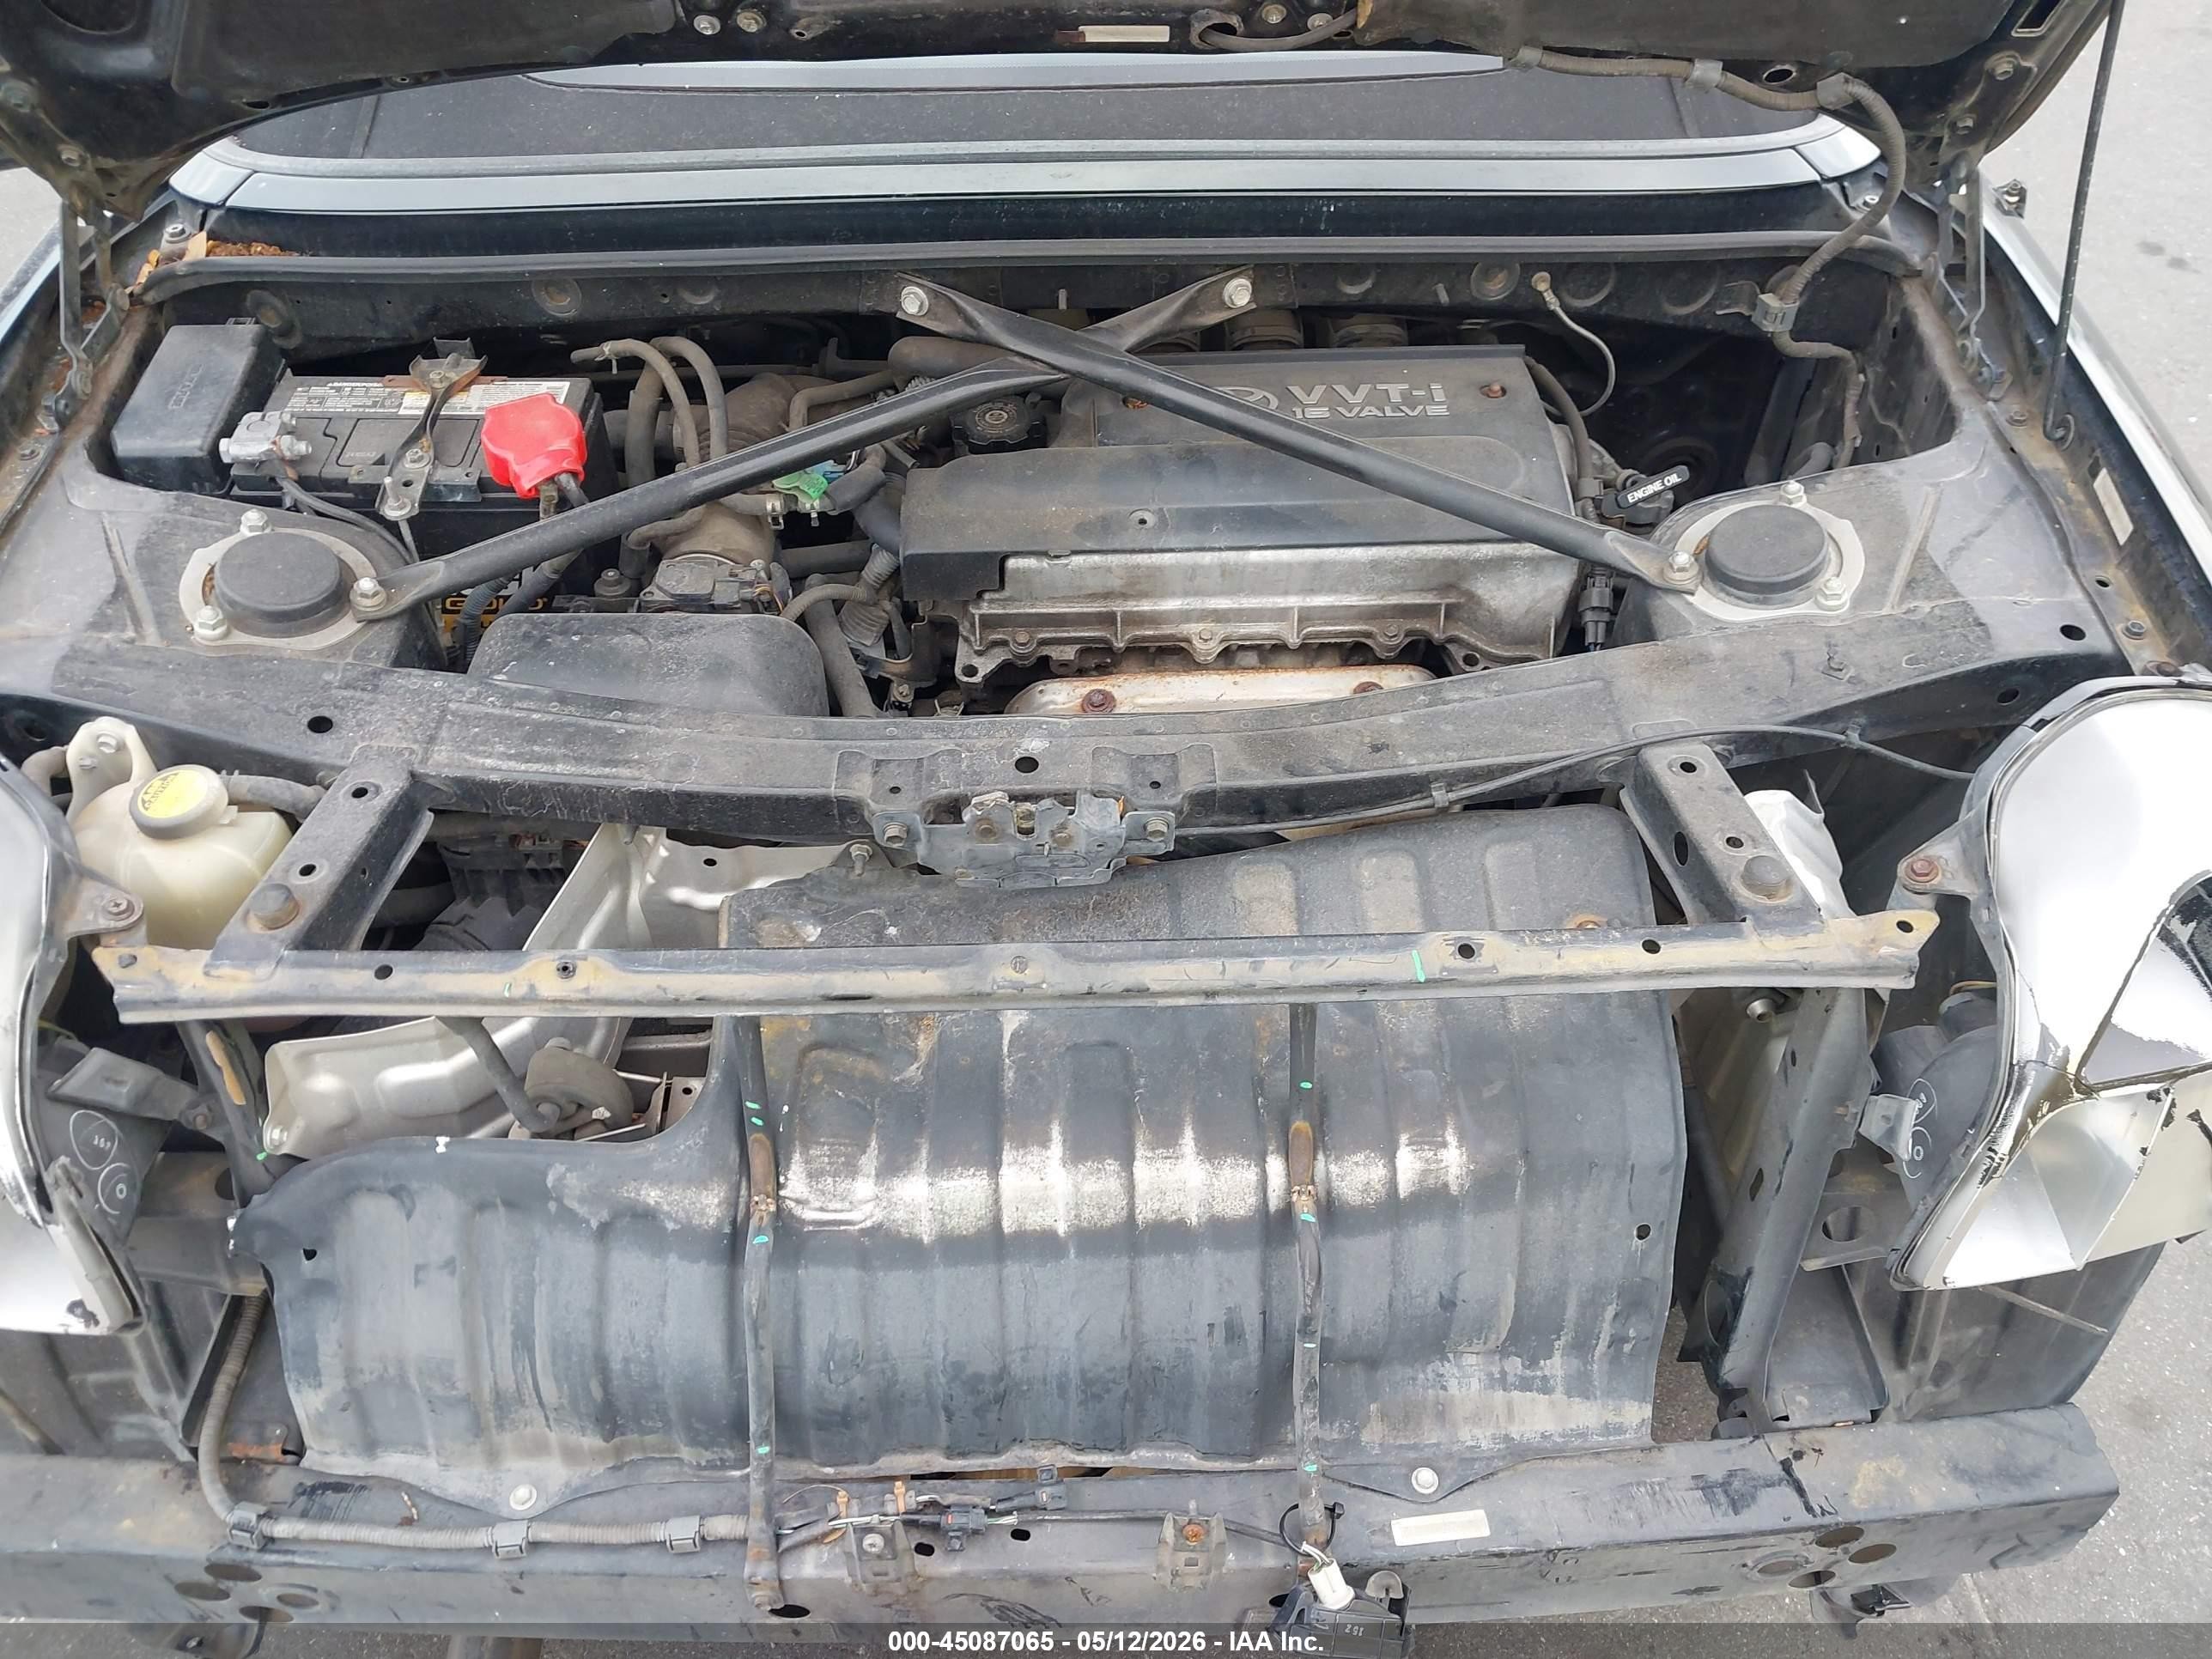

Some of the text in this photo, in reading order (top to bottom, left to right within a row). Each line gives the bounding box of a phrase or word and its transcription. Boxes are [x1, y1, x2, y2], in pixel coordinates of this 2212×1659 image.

[1286, 383, 1447, 405] VVT-i
[1291, 404, 1450, 419] 16 VALVE
[1627, 472, 1682, 504] ENGINE OIL
